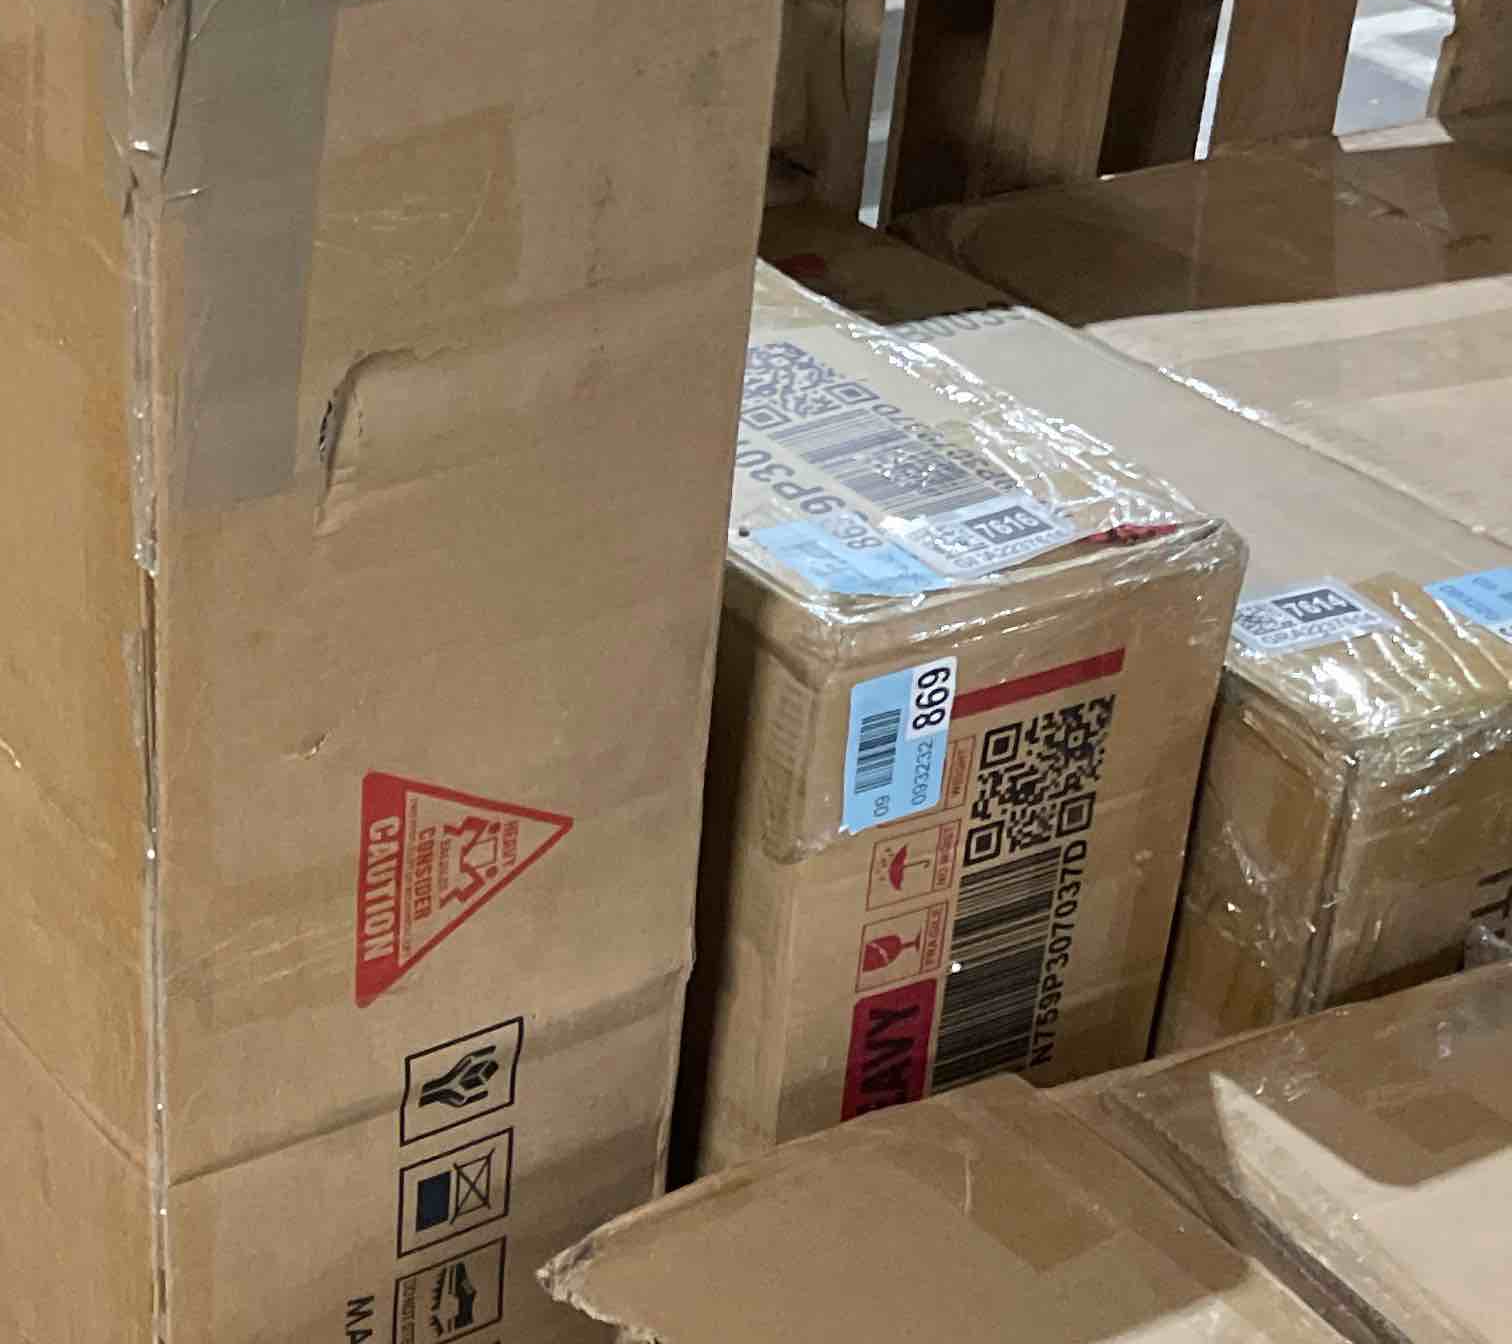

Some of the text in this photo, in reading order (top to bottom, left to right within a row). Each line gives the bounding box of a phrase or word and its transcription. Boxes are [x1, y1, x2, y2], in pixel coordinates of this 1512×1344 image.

[974, 512, 1039, 539] 7616
[1282, 593, 1349, 618] 7614
[912, 667, 951, 730] 869
[911, 740, 935, 806] 093232
[872, 794, 891, 817] 09
[362, 815, 400, 962] CAUTION
[414, 826, 437, 921] CONSIDER
[1029, 840, 1088, 1067] N759P307037D
